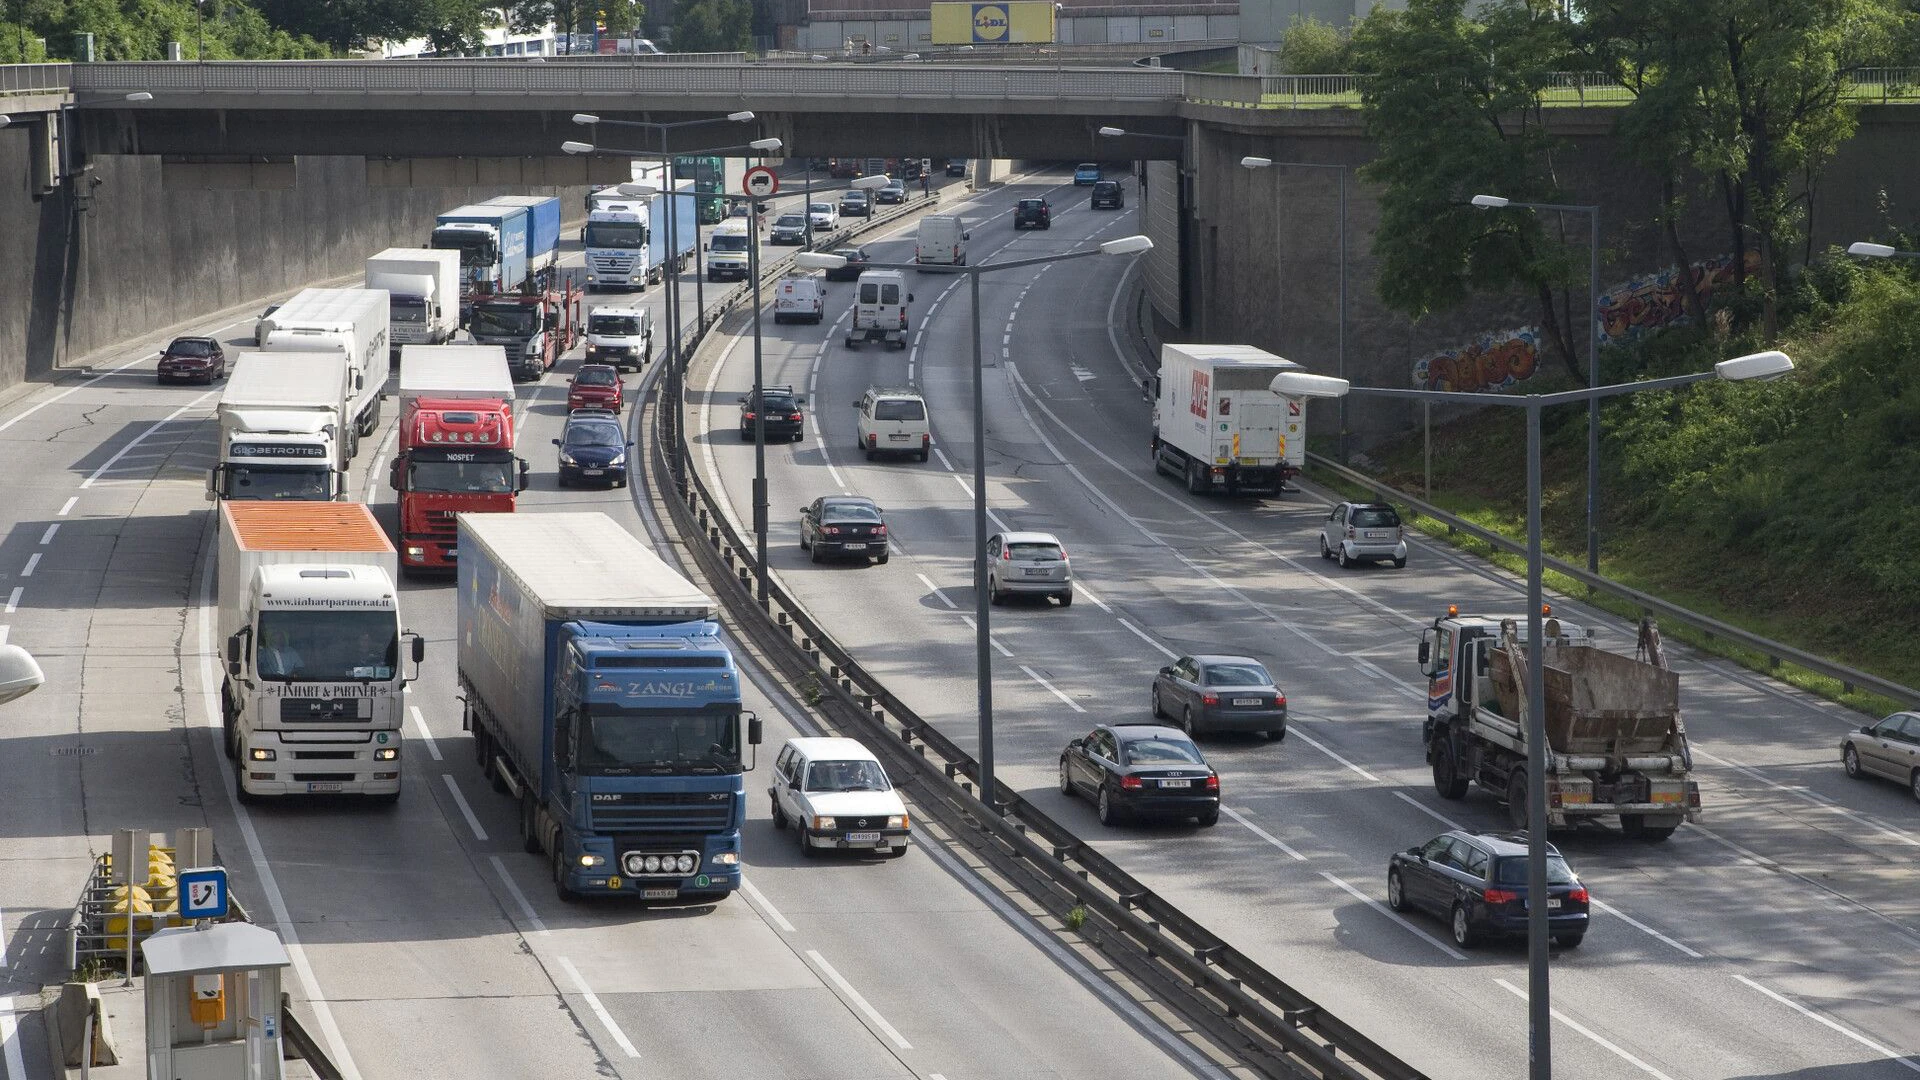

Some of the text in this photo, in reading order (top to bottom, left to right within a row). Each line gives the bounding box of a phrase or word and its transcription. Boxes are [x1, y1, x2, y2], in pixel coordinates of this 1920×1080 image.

[233, 446, 323, 455] GLOBETROTTER
[277, 685, 377, 698] LINHART & PARTNER
